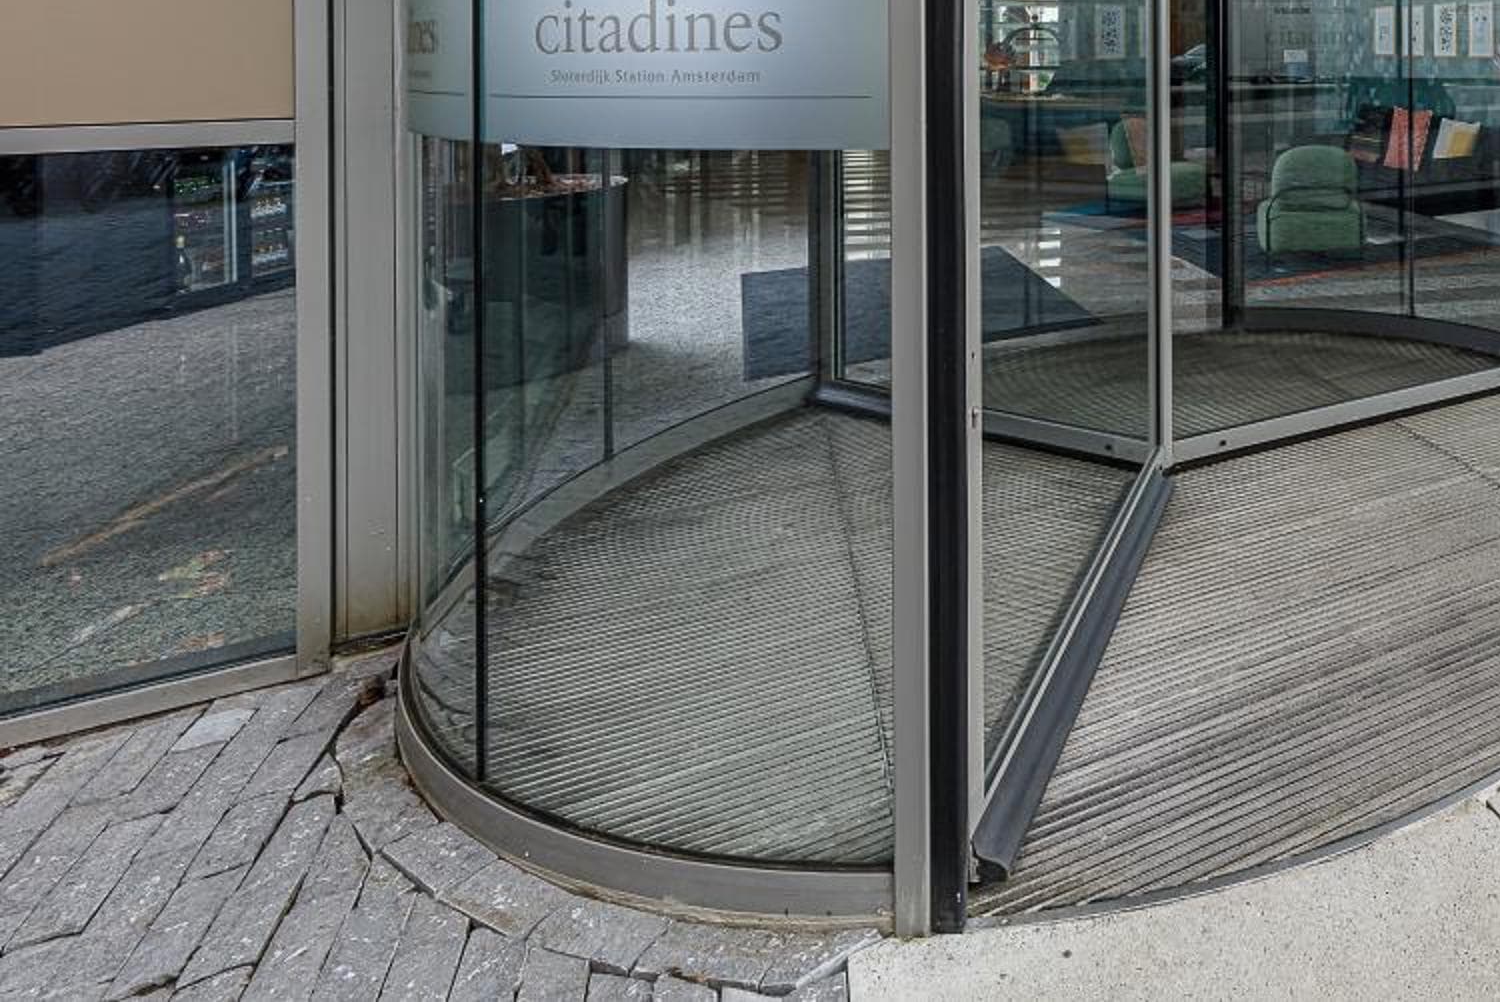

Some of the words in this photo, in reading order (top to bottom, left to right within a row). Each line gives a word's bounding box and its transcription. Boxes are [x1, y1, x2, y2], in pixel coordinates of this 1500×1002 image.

[550, 69, 611, 85] Sloterdijk
[616, 69, 666, 84] Station
[671, 69, 761, 84] Amsterdam
